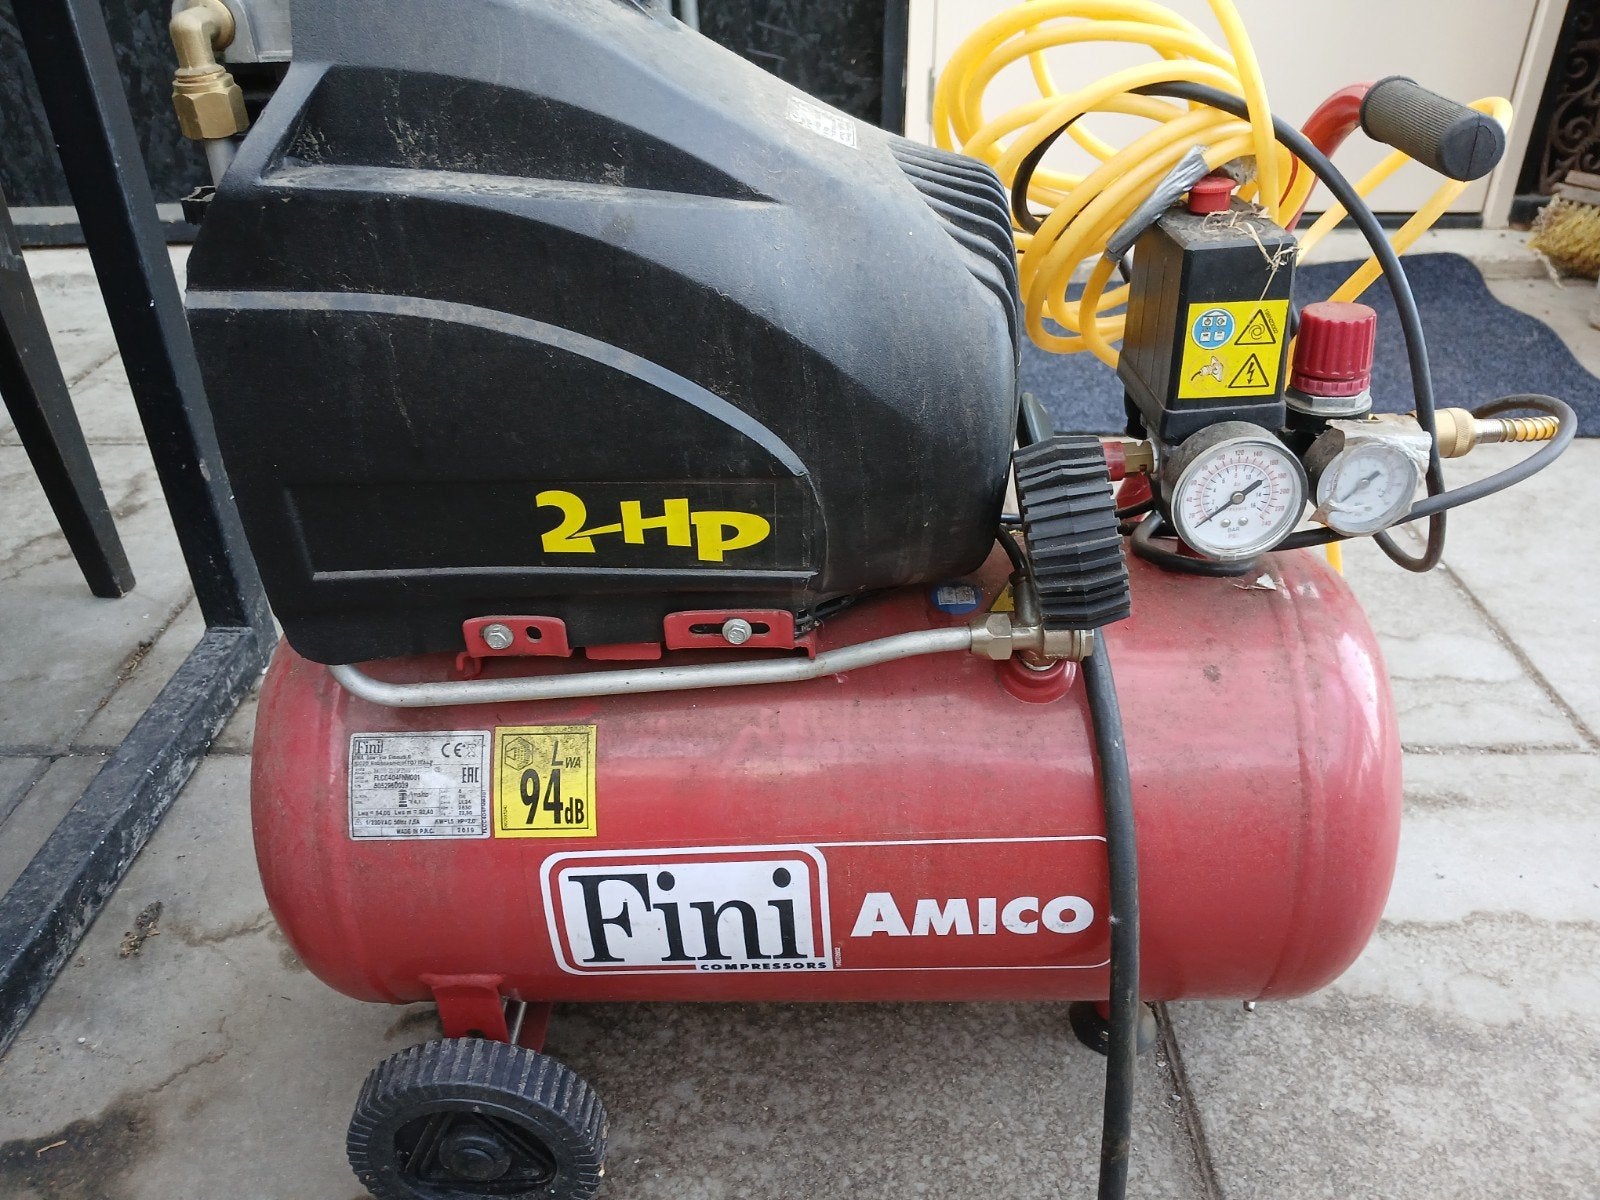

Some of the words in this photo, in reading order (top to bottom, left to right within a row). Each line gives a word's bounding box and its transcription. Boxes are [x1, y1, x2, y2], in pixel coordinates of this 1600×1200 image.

[355, 739, 382, 754] Fini
[568, 867, 807, 963] Fini
[700, 961, 827, 971] COMPRESSORS
